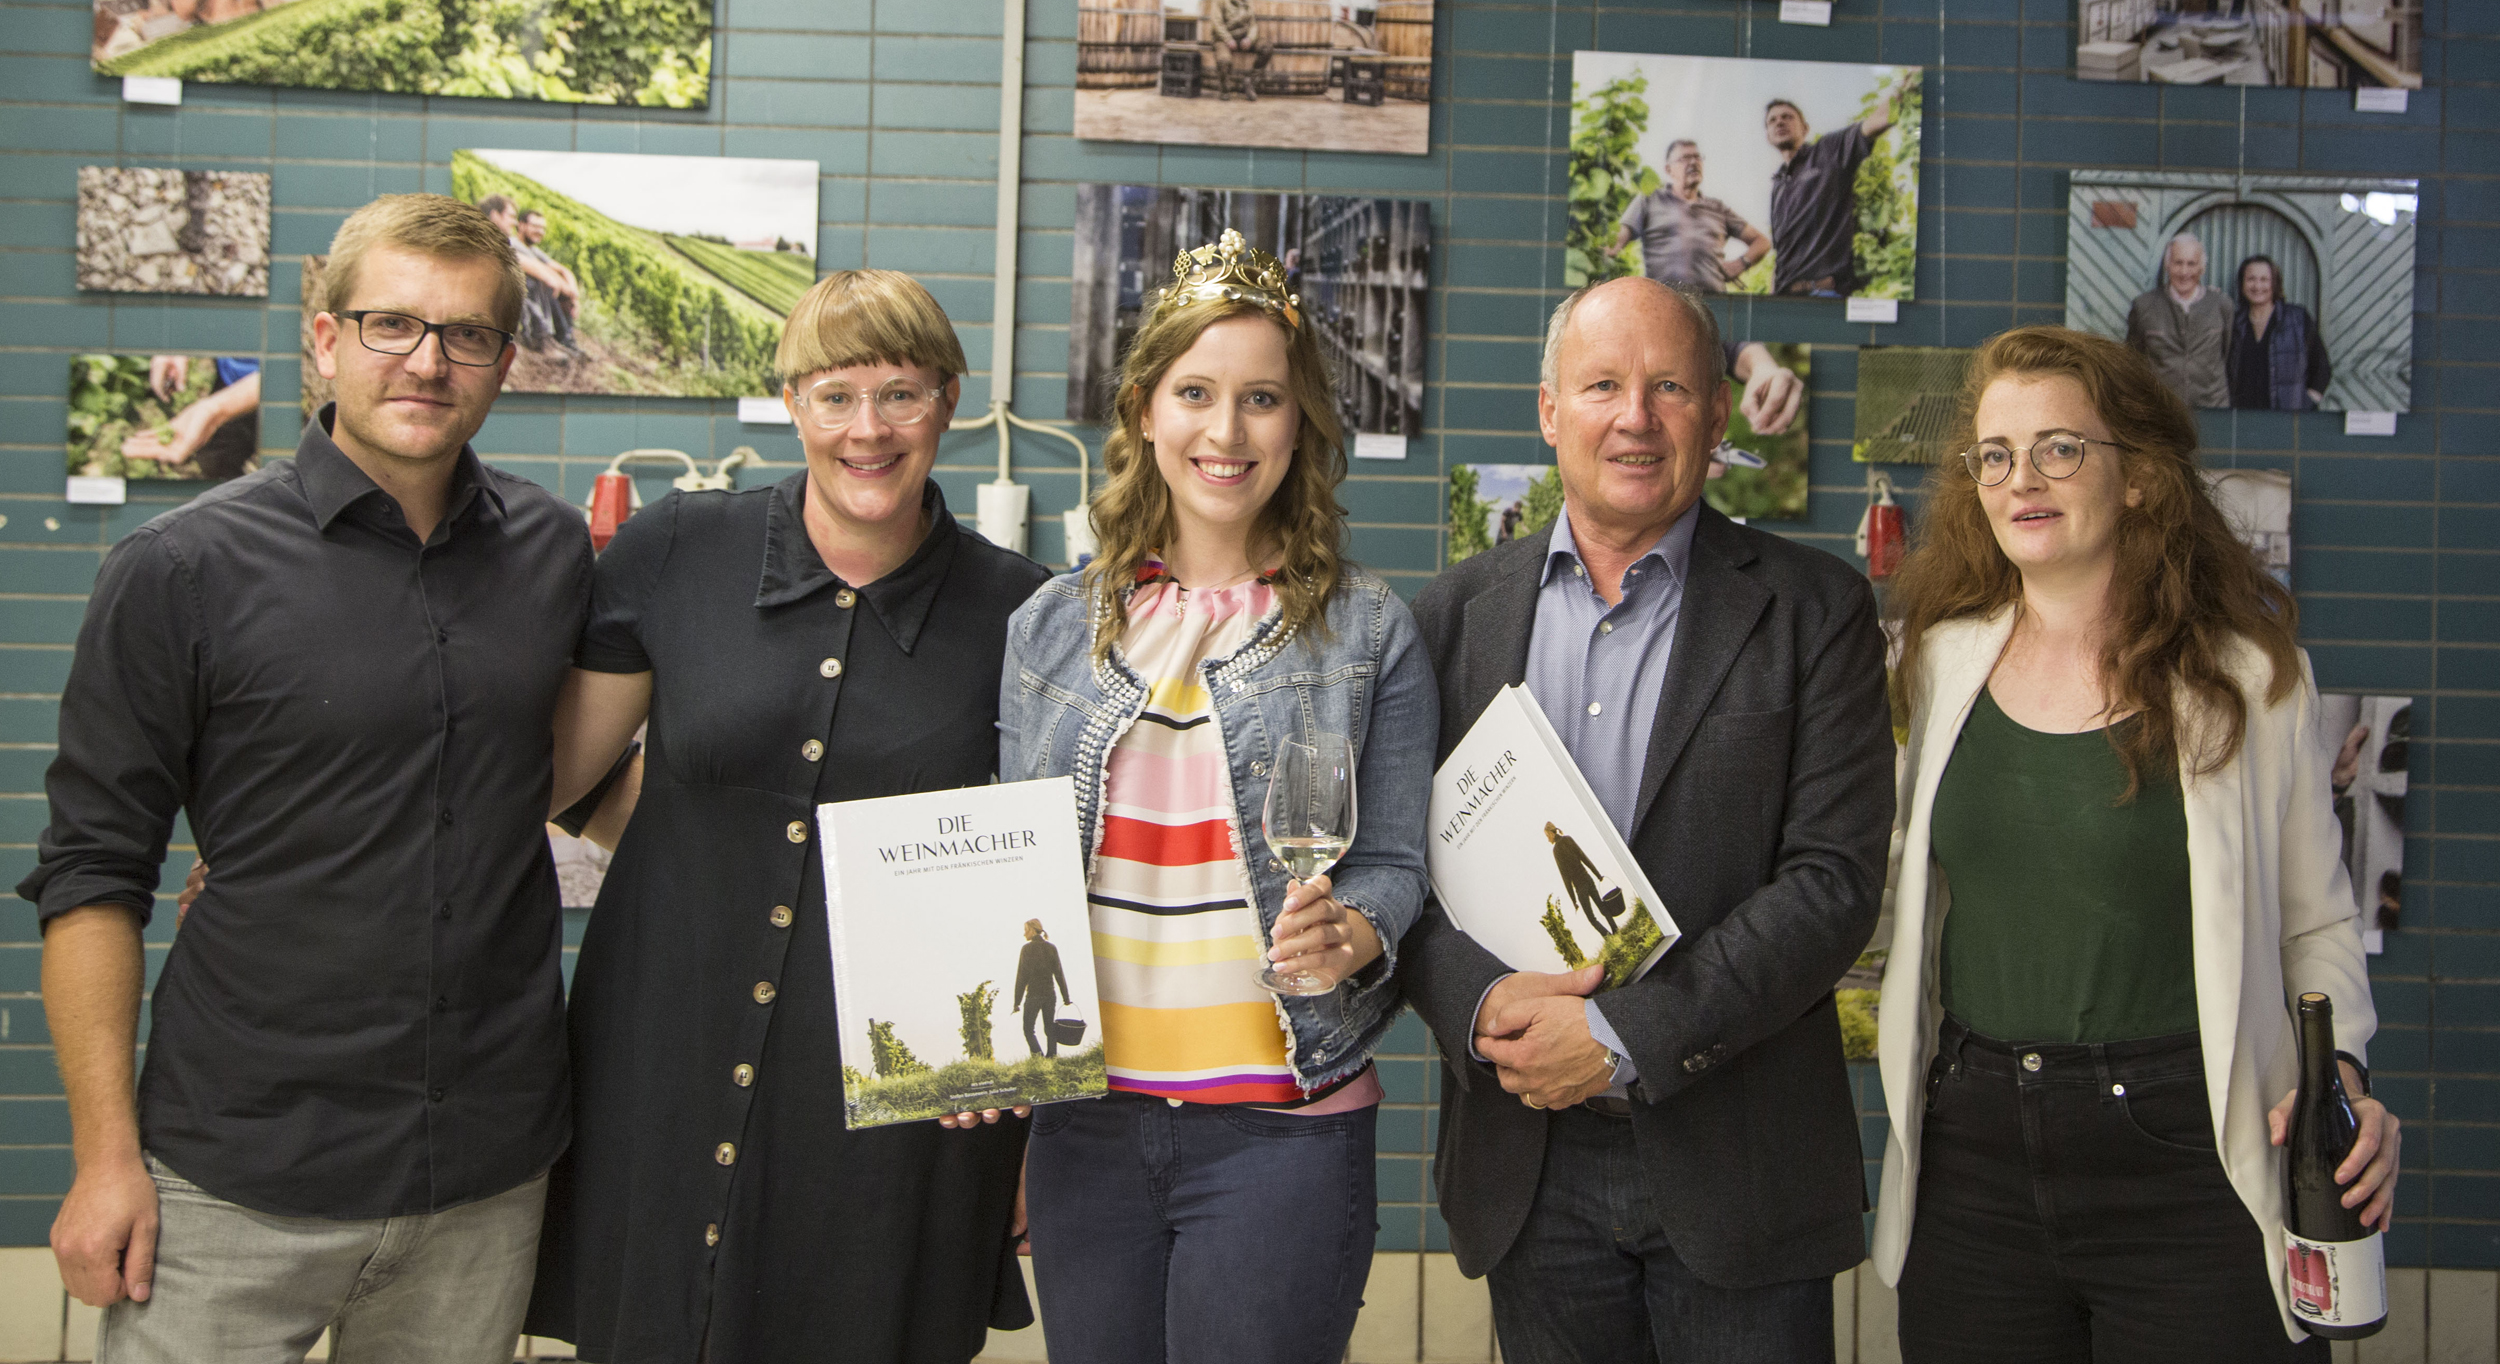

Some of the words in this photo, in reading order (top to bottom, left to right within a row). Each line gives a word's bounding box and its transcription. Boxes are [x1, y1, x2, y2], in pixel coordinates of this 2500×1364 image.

[1456, 765, 1479, 795] DIE
[1440, 750, 1517, 844] WEINMACHER
[938, 814, 974, 834] DIE
[878, 830, 1036, 863] WEINMACHER
[950, 859, 994, 870] FRÄNKISCHEN
[995, 855, 1024, 864] WINZERN
